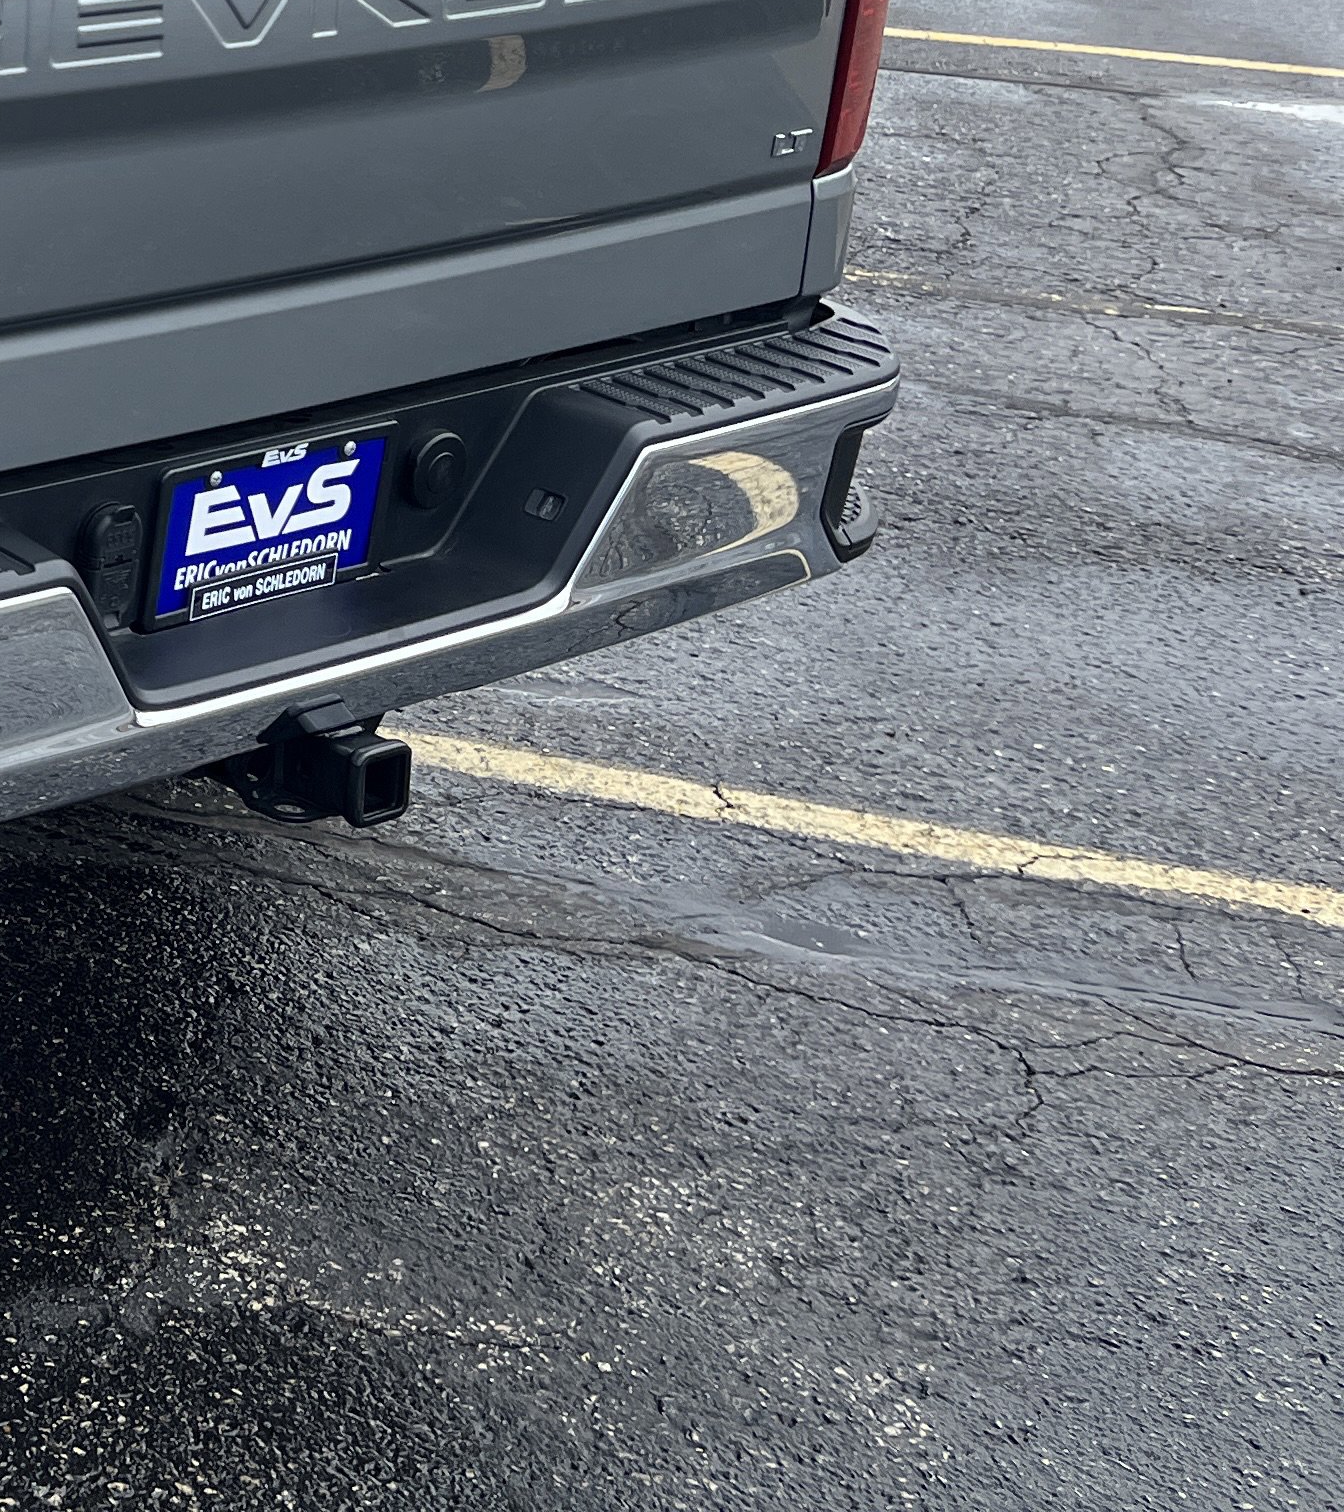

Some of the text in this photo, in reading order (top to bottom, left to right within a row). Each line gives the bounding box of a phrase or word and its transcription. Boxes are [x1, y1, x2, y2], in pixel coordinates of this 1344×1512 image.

[771, 128, 813, 158] LT
[201, 562, 327, 610] ERIC von SCHLEDORN
